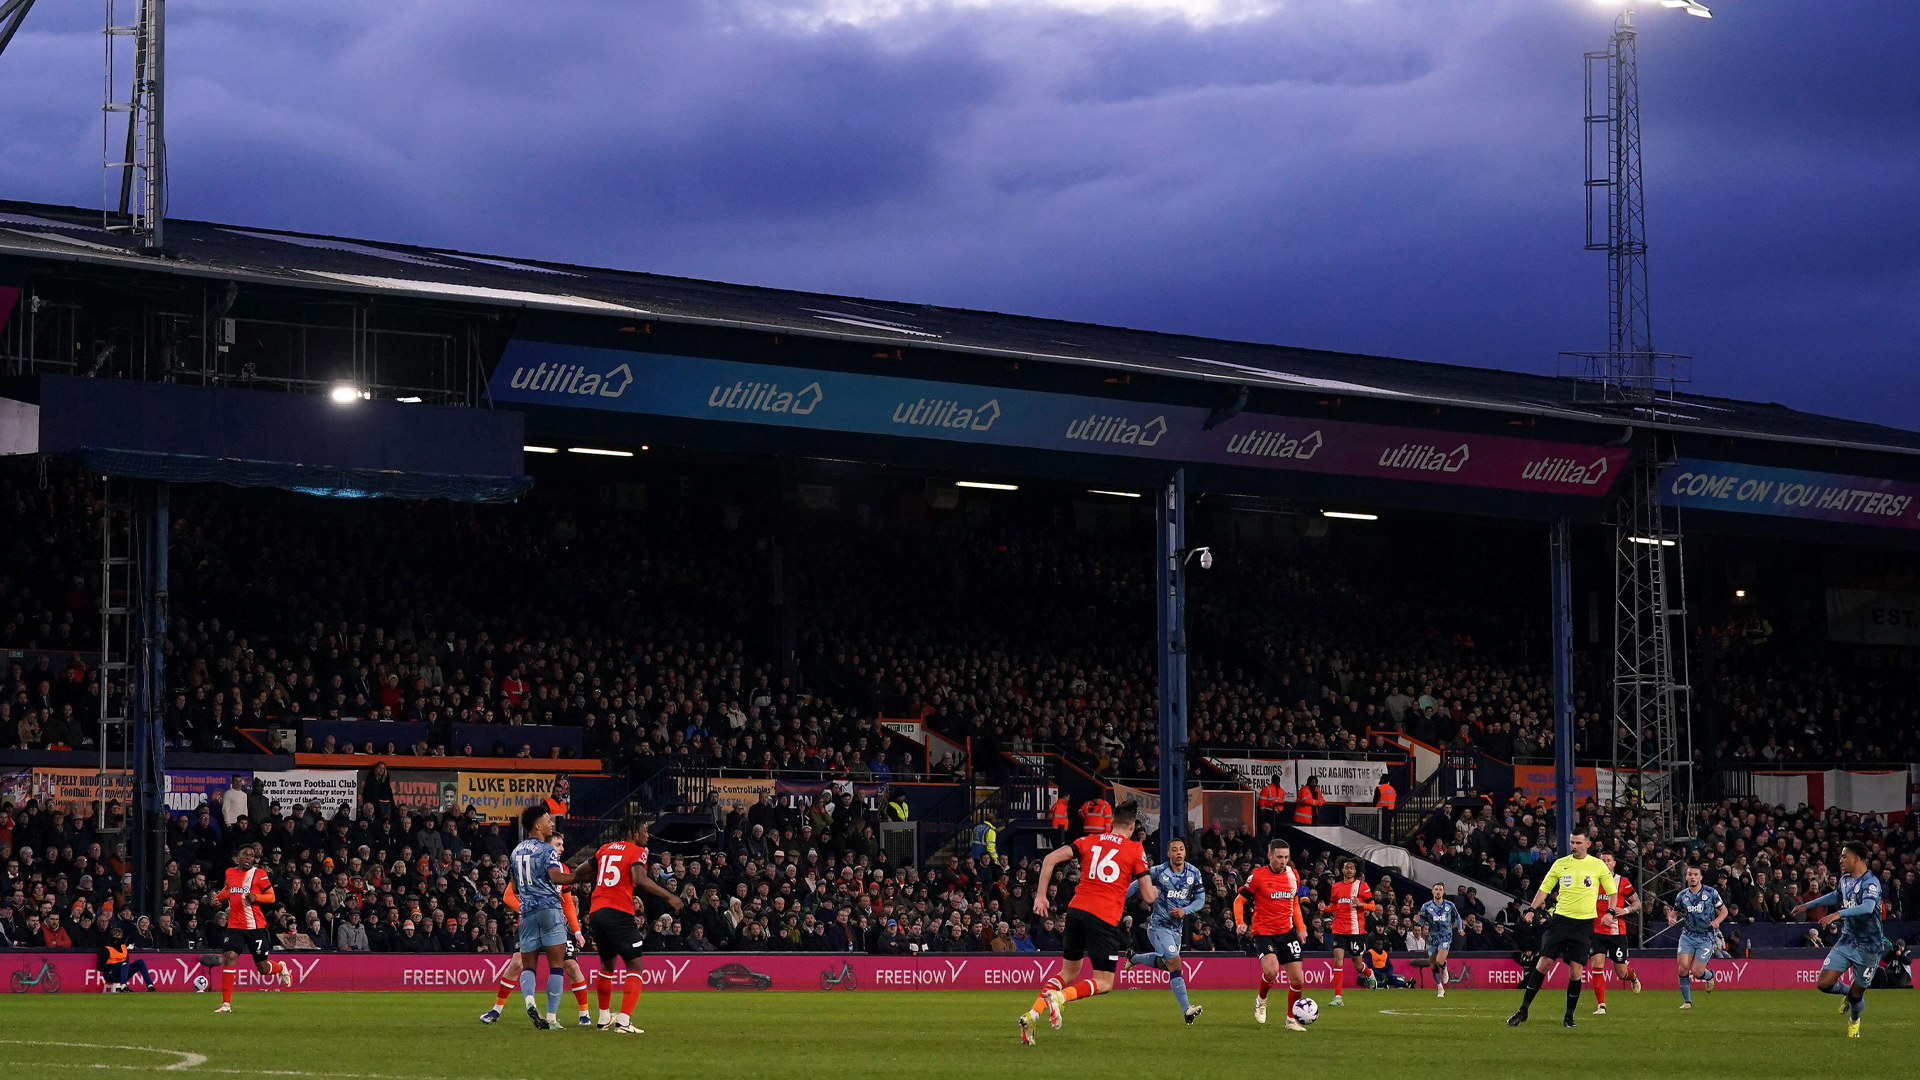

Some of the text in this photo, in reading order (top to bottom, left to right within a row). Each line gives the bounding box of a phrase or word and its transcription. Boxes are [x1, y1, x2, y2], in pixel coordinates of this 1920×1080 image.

[510, 362, 601, 395] utilita
[708, 381, 793, 413] utilita
[892, 398, 973, 428] utilita
[1066, 415, 1141, 444] utilita
[1226, 430, 1298, 458] utilita
[1379, 444, 1447, 471] utilita
[1521, 457, 1587, 483] utilita
[1671, 472, 1913, 517] COME ON YOU HATTERS!
[1871, 608, 1915, 628] EST.
[1251, 764, 1283, 776] BELONGS
[1328, 766, 1356, 779] AGAINST
[1357, 768, 1370, 779] THE
[56, 775, 77, 785] PELLY
[80, 775, 113, 787] RUDDCK
[262, 779, 357, 788] ton Town Football Club
[398, 781, 437, 795] JUSTIN
[469, 777, 555, 793] LUKE BERRY
[60, 787, 132, 799] Football: Cmpletd
[287, 788, 330, 797] extraordinary
[331, 788, 346, 797] story
[1334, 784, 1340, 796] IS
[1341, 785, 1354, 796] FOR
[164, 792, 208, 811] WARDS
[271, 796, 293, 805] history
[312, 796, 336, 805] nglish
[337, 797, 353, 805] game
[461, 793, 546, 809] Poetry in Motio
[1126, 791, 1161, 810] PRID
[1099, 833, 1123, 845] BURKE
[515, 854, 533, 886] 11
[596, 854, 622, 887] 15
[1088, 845, 1121, 883] 16
[255, 939, 263, 951] 7
[565, 940, 575, 952] 5
[1287, 940, 1302, 954] 18
[1350, 941, 1360, 951] 14
[1615, 947, 1623, 958] 6
[1700, 947, 1710, 958] 7
[85, 969, 177, 985] FRNOW
[233, 969, 292, 985] ENOW
[403, 969, 486, 985] FREENOW
[589, 969, 667, 985] FEEOW
[876, 969, 946, 985] FREENOW
[984, 969, 1035, 984] EENOW
[1119, 969, 1183, 984] FREENO
[1488, 970, 1524, 984] FREEN
